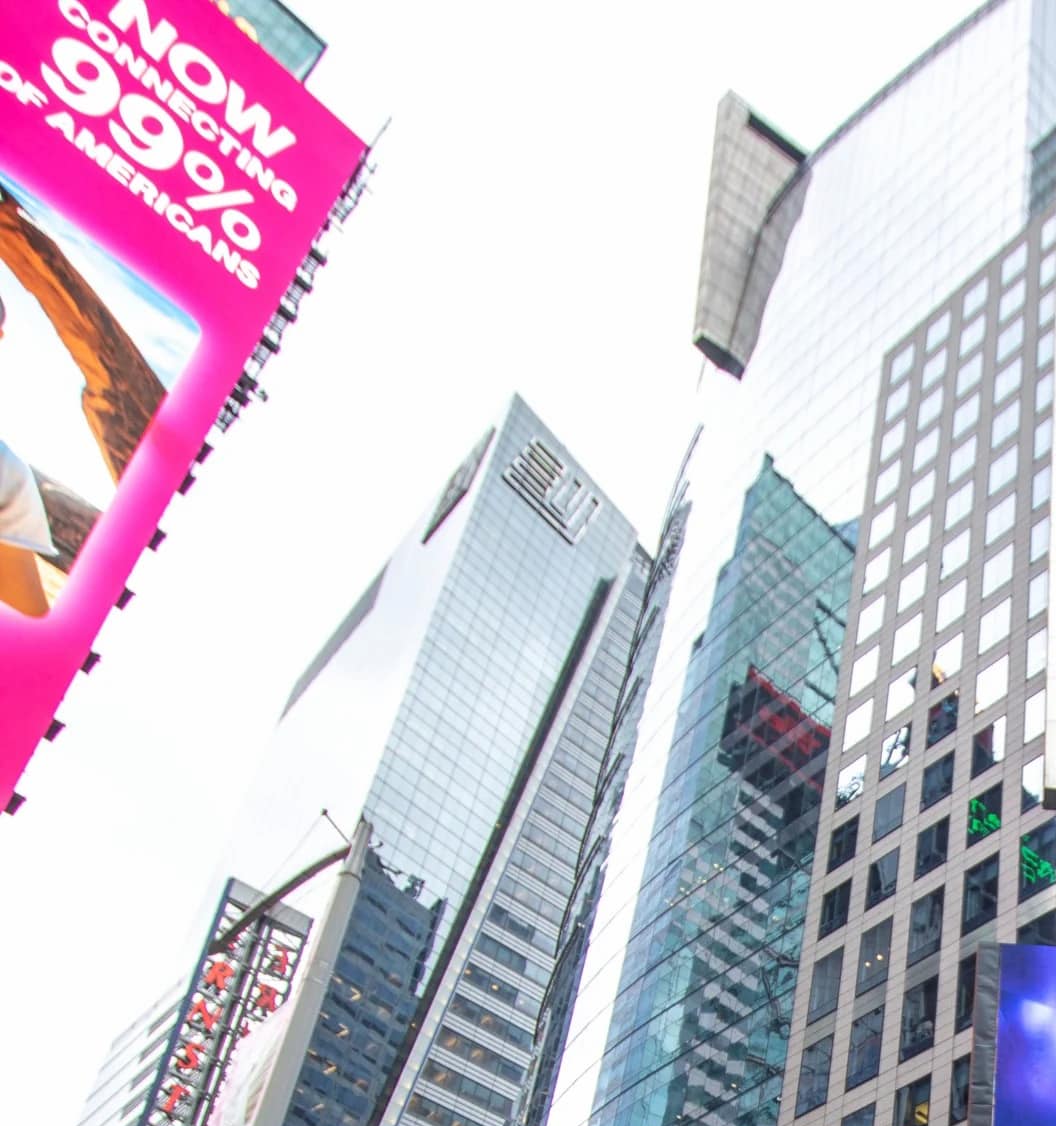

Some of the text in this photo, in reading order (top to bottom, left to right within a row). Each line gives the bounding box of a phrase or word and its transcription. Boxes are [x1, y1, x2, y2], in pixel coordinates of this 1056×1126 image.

[0, 59, 260, 290] OF AMERICANS
[40, 37, 262, 251] 99%
[57, 0, 298, 213] CONNECTING
[108, 0, 296, 158] NOW
[165, 926, 250, 1113] RNST
